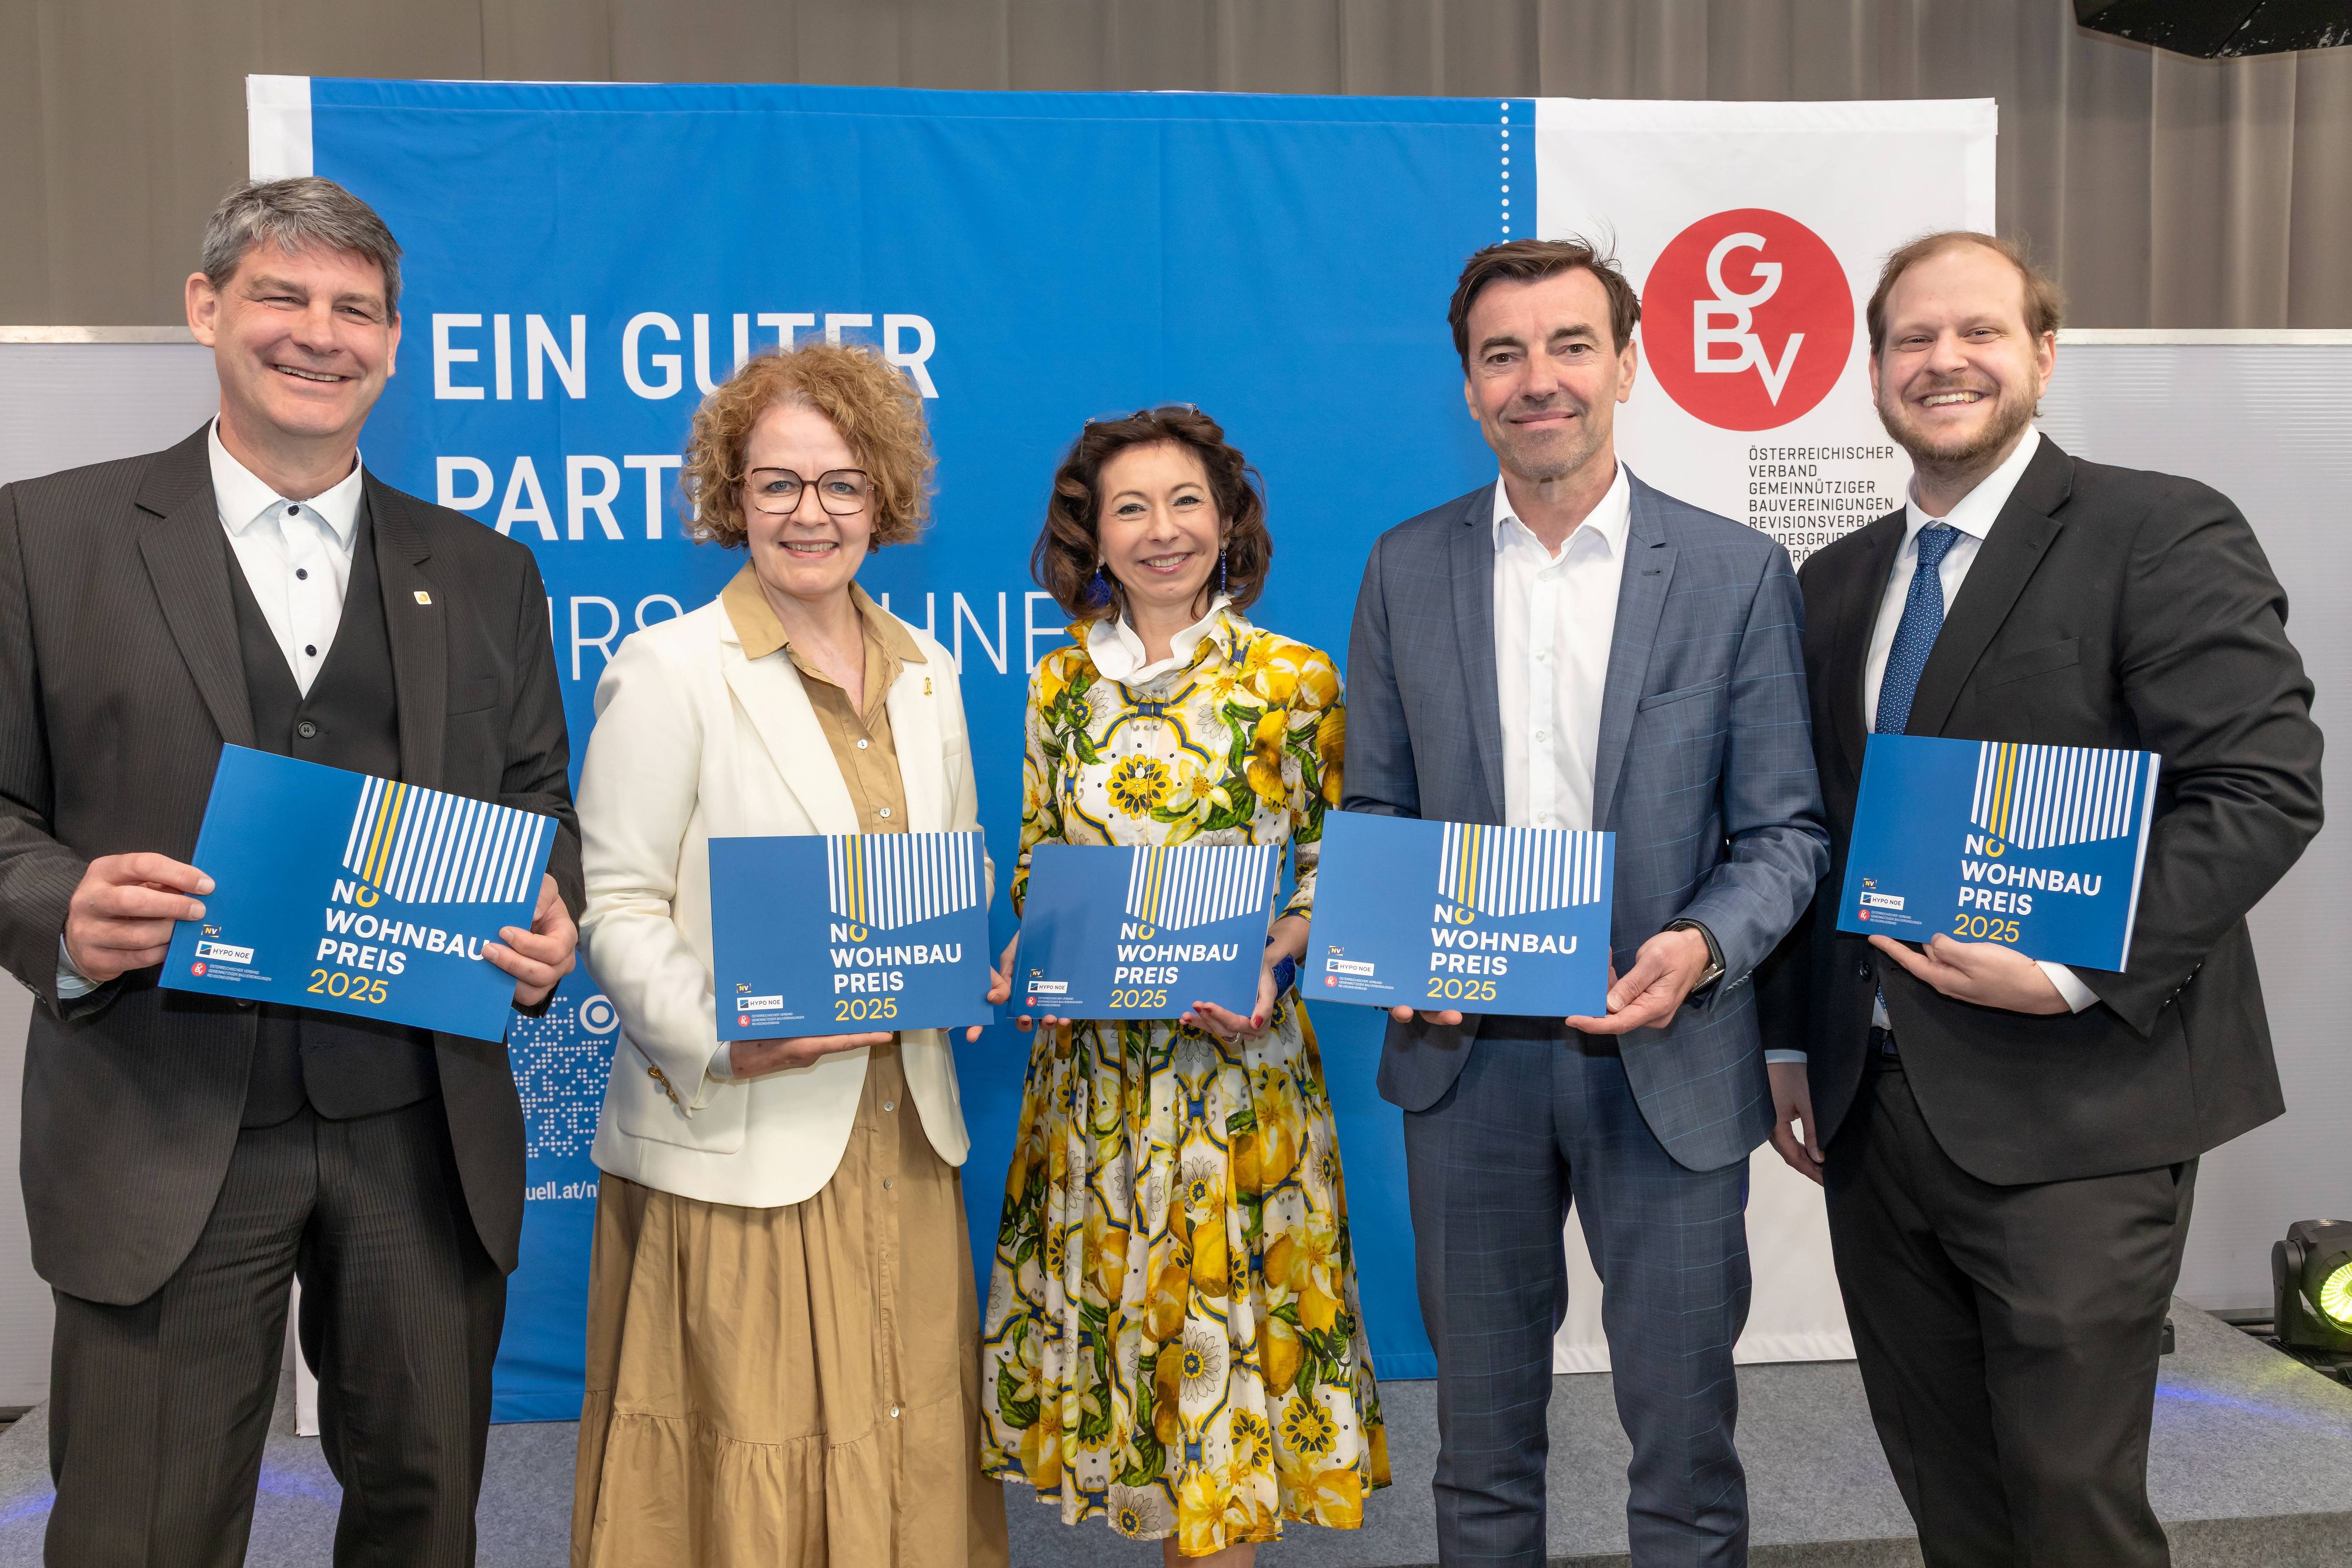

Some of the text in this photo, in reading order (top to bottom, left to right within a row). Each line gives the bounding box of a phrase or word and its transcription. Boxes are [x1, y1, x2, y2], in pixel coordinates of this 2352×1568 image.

[432, 313, 586, 400] EIN
[1749, 445, 1894, 460] ÖSTERREICHISCHER
[1749, 464, 1817, 477] VERBAND
[1749, 479, 1875, 494] GEMEINNÜTZIGER
[1749, 497, 1893, 511] BAUVEREINIGUNGEN
[1961, 860, 2102, 896] WOHNBAU
[1957, 887, 2033, 915] PREIS
[325, 908, 490, 961] WOHNBAU
[1953, 914, 2020, 942] 2025
[1431, 927, 1577, 954] WOHNBAU
[213, 948, 233, 957] HYPO
[316, 938, 406, 975] PREIS
[830, 943, 962, 968] WOHNBAU
[1117, 944, 1238, 962] WOHNBAU
[1430, 952, 1508, 976] PREIS
[307, 969, 388, 1004] 2025
[834, 971, 904, 994] PREIS
[1114, 967, 1178, 984] PREIS
[1109, 989, 1168, 1008] 2025
[1426, 977, 1497, 1001] 2025
[835, 998, 898, 1021] 2025
[526, 1179, 599, 1201] uell.at/n
